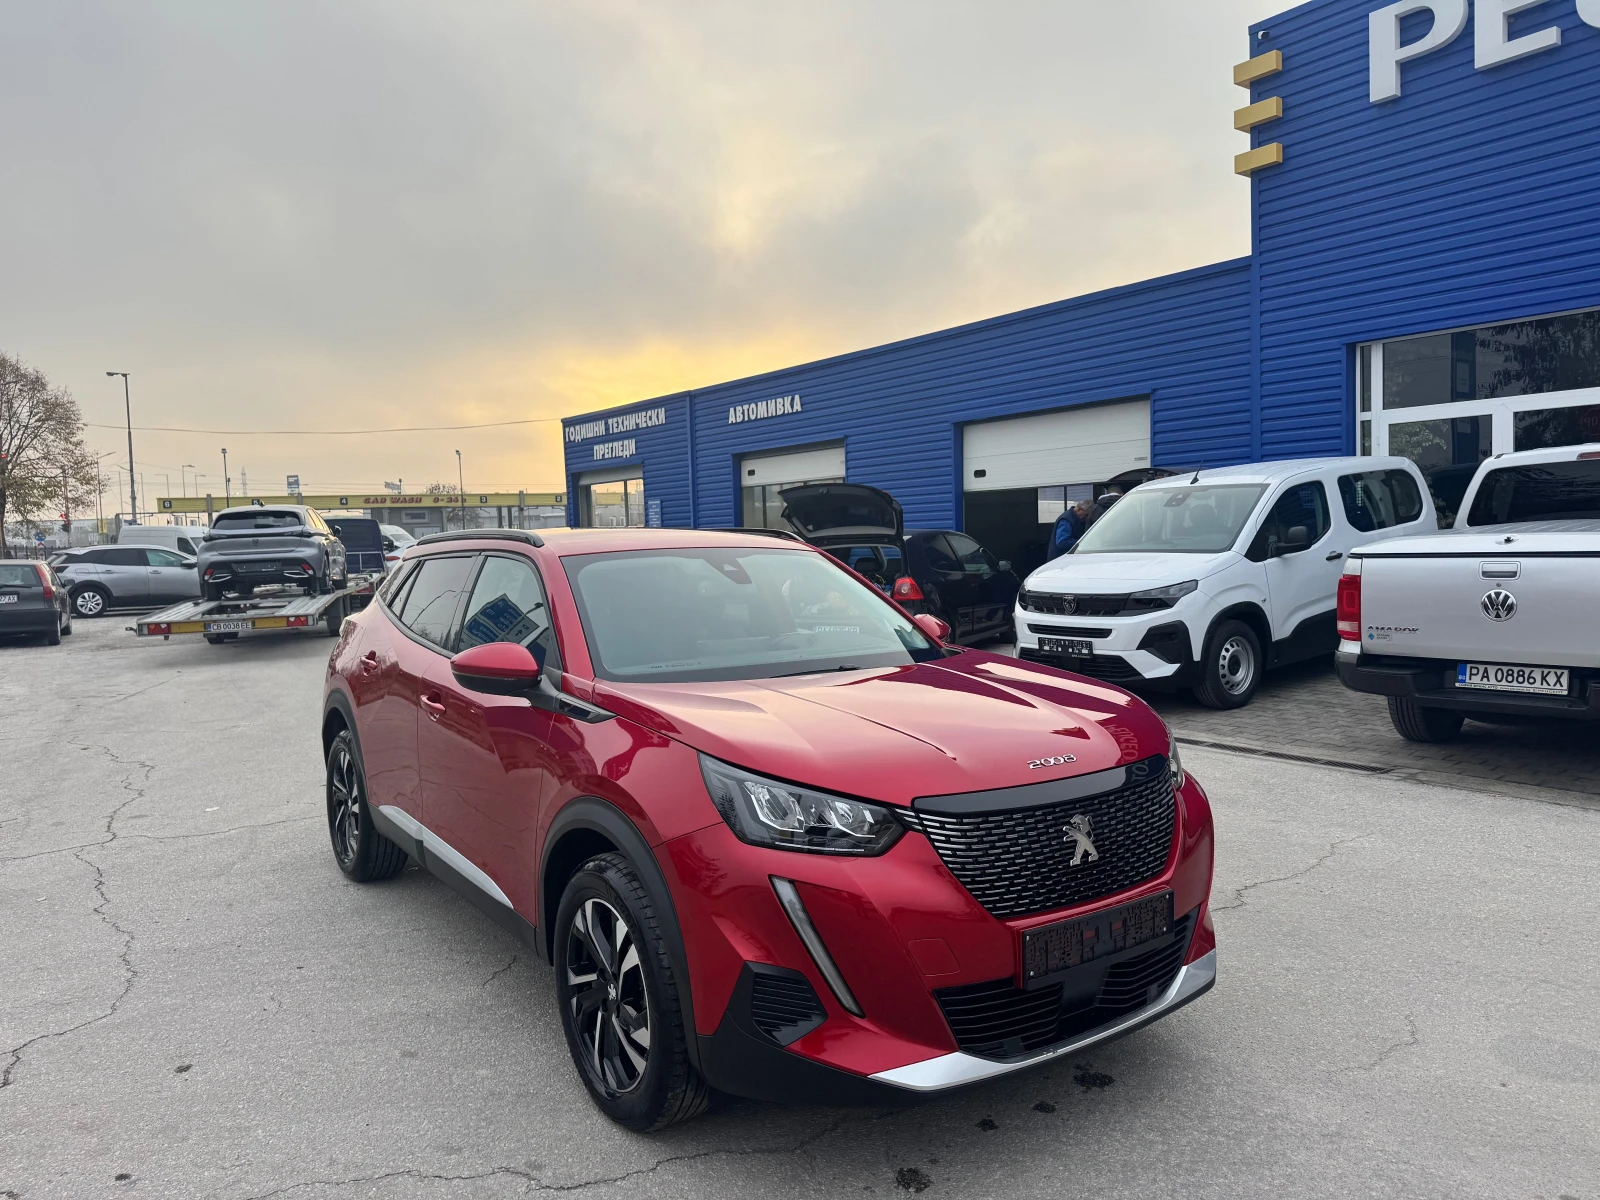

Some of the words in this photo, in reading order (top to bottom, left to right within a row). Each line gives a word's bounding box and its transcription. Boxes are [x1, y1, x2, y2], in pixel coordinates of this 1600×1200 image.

[1369, 0, 1600, 103] PE
[728, 394, 802, 425] АВТОМИВКА
[565, 420, 606, 443] ГОДИШНИ
[607, 407, 666, 434] ТЕХНИЧЕСКИ
[593, 438, 636, 460] ПРЕГЛЕДИ
[389, 496, 423, 504] WASH
[1468, 665, 1490, 682] PA
[1494, 667, 1537, 685] 0886
[1540, 670, 1565, 687] KX
[1026, 753, 1077, 770] 2008
